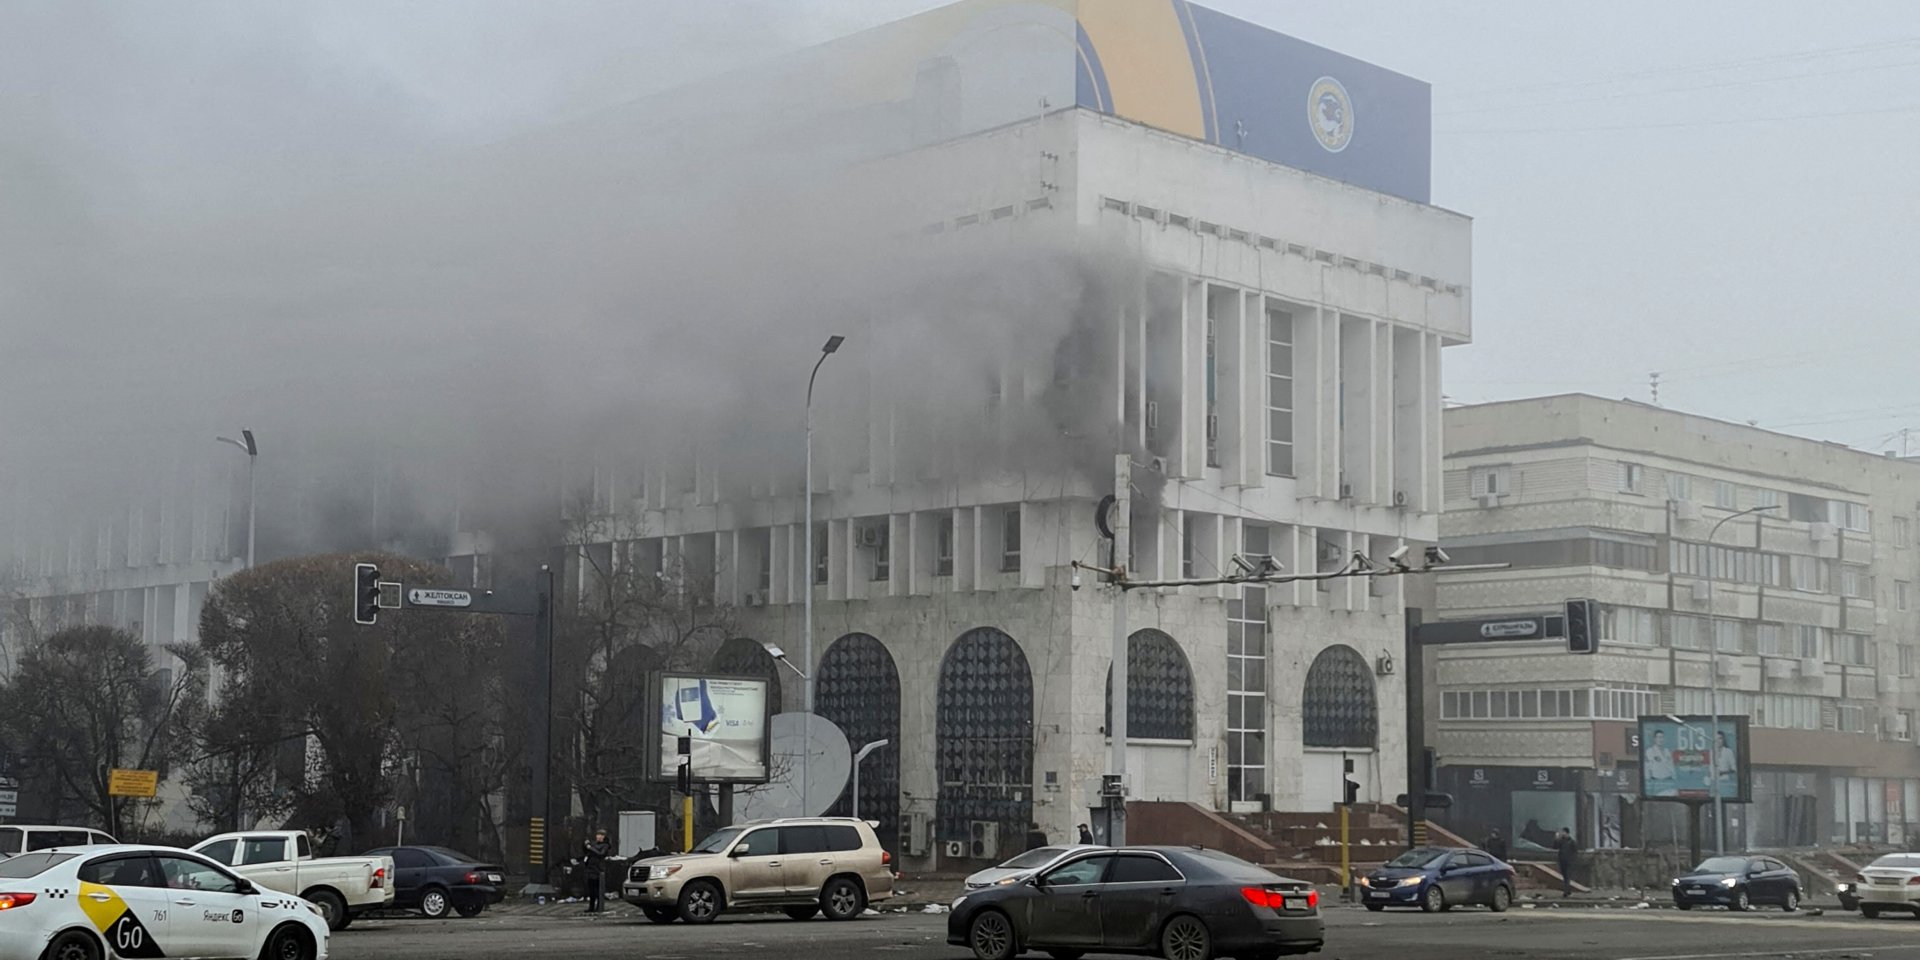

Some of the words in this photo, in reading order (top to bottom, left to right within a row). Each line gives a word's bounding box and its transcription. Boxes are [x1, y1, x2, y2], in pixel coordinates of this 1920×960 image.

[153, 910, 167, 921] 761
[203, 909, 229, 922] Яндекс
[233, 910, 243, 921] Go
[117, 917, 142, 949] Go
